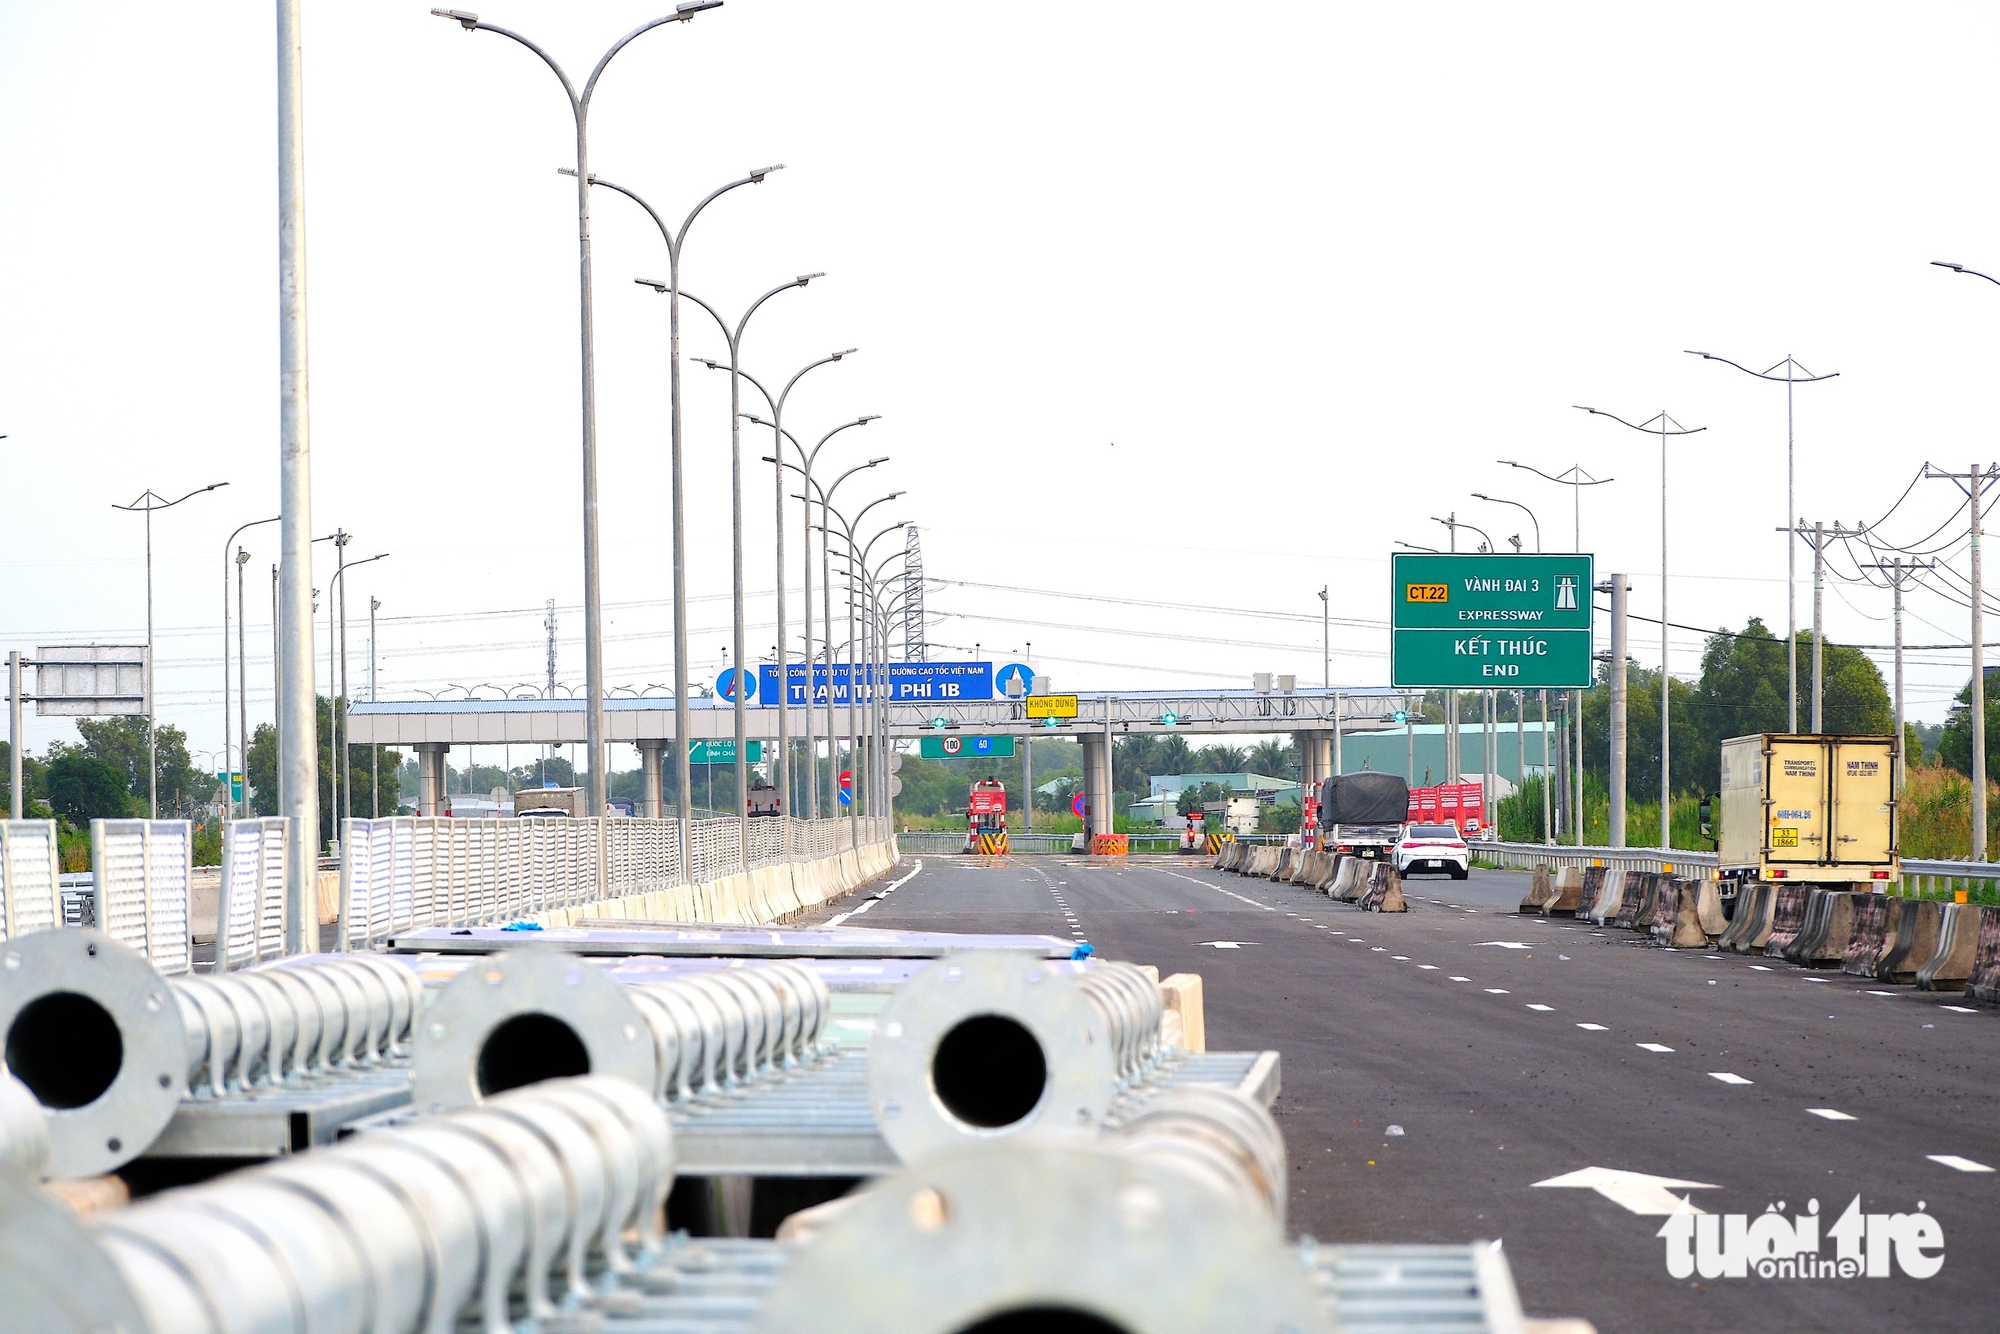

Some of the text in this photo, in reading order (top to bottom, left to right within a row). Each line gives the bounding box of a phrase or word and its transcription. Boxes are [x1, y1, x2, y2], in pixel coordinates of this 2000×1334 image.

[1465, 576, 1540, 592] VÀNH ĐAI 3
[1409, 587, 1446, 600] CT.22
[1458, 610, 1544, 621] EXPRESSWAY
[1454, 634, 1548, 656] KẾT THÚC
[918, 667, 934, 675] CAO
[935, 664, 950, 675] TỐC
[950, 666, 966, 677] VIỆT
[967, 667, 984, 675] NAM
[1482, 664, 1520, 677] END
[900, 677, 933, 698] PHÍ
[938, 682, 961, 698] 1B
[946, 740, 958, 750] 100
[978, 739, 988, 749] 60
